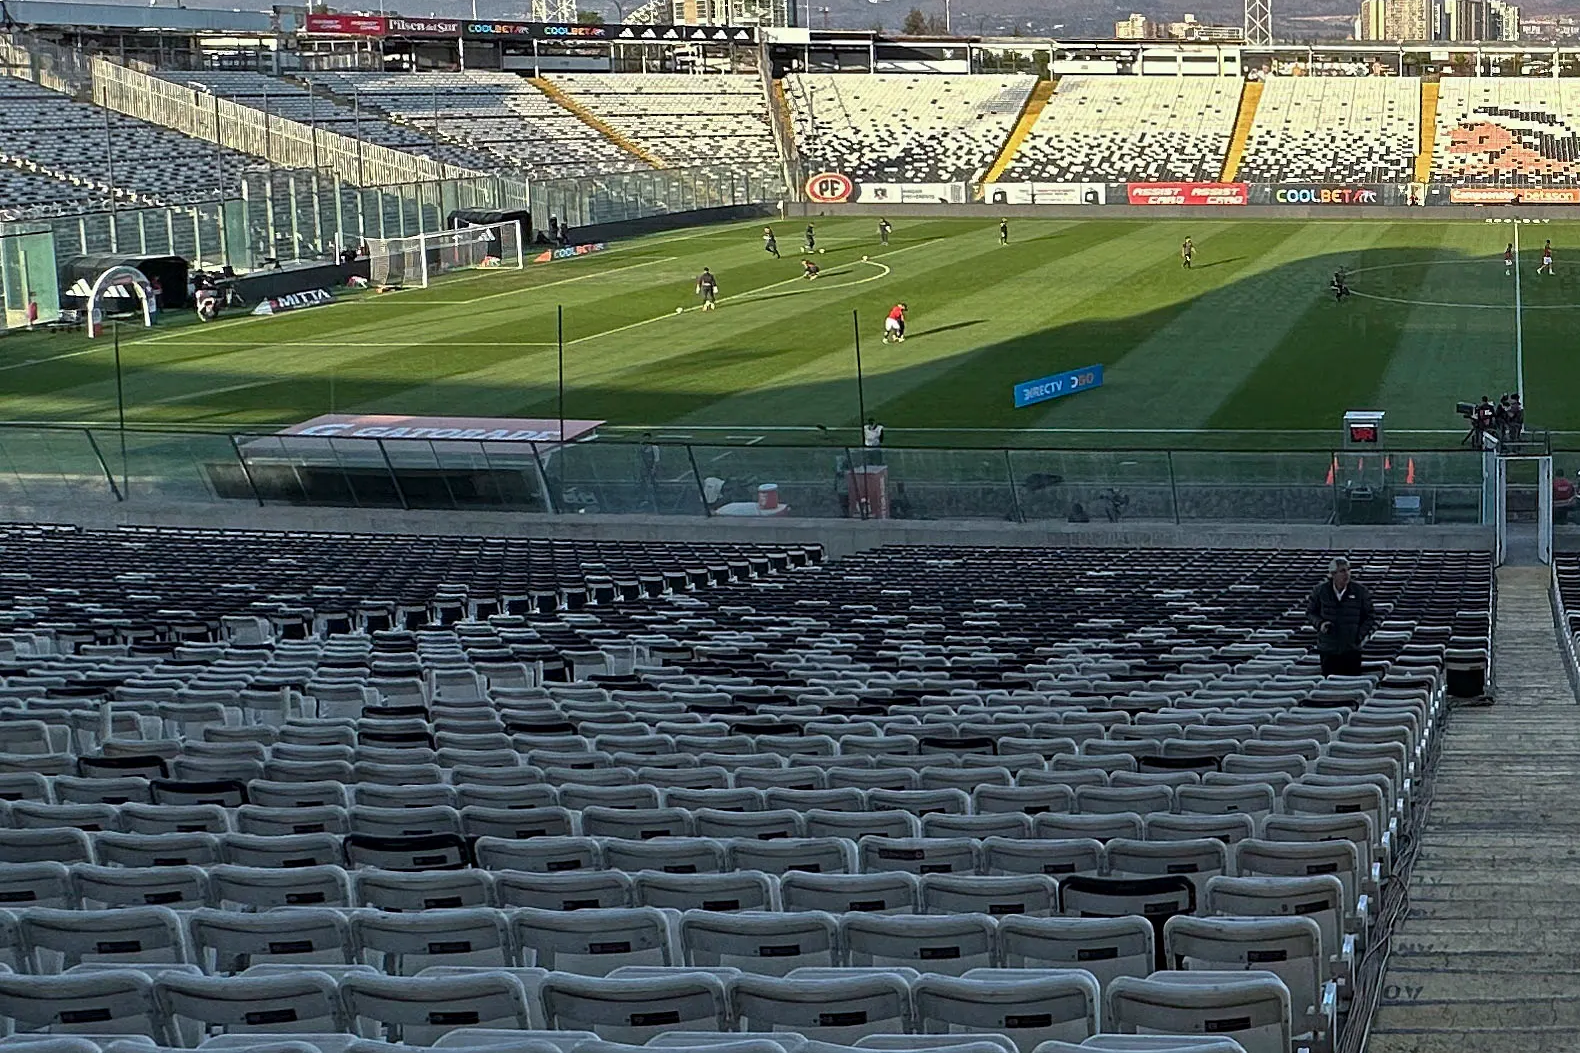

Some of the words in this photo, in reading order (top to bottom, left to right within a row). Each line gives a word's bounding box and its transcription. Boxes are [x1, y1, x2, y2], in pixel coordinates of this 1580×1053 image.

[468, 23, 516, 34] COOLBET
[544, 26, 591, 36] COOLBET
[818, 180, 840, 196] PF
[1132, 187, 1182, 196] ASSIST
[1190, 187, 1240, 196] ASSIST
[1276, 190, 1352, 203] COOLBET
[278, 289, 331, 308] MITTA
[1023, 380, 1063, 401] DIRECTV
